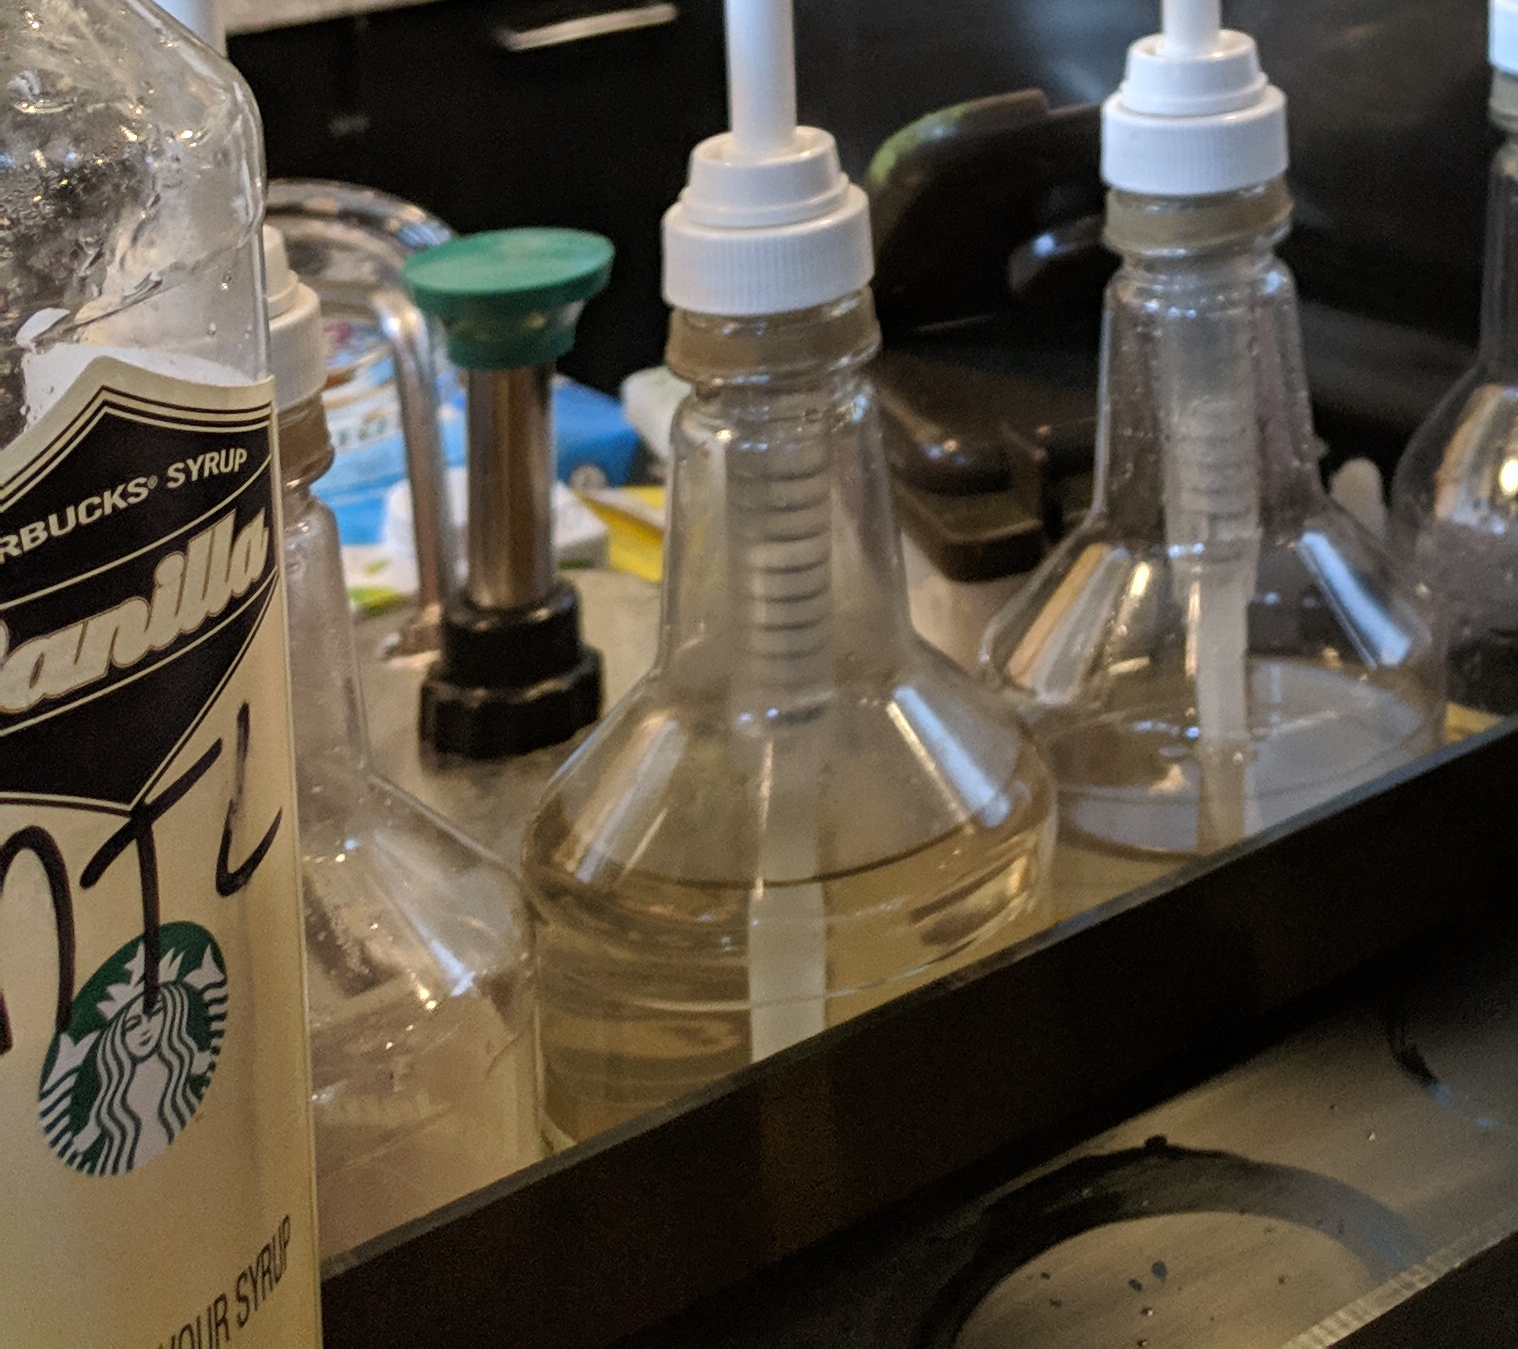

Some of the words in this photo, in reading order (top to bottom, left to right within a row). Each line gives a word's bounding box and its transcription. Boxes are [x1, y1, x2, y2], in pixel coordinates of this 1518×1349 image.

[166, 448, 248, 488] SYRUP
[0, 506, 270, 714] anilla
[157, 1293, 230, 1349] OUR
[235, 1214, 291, 1328] SYRUP
